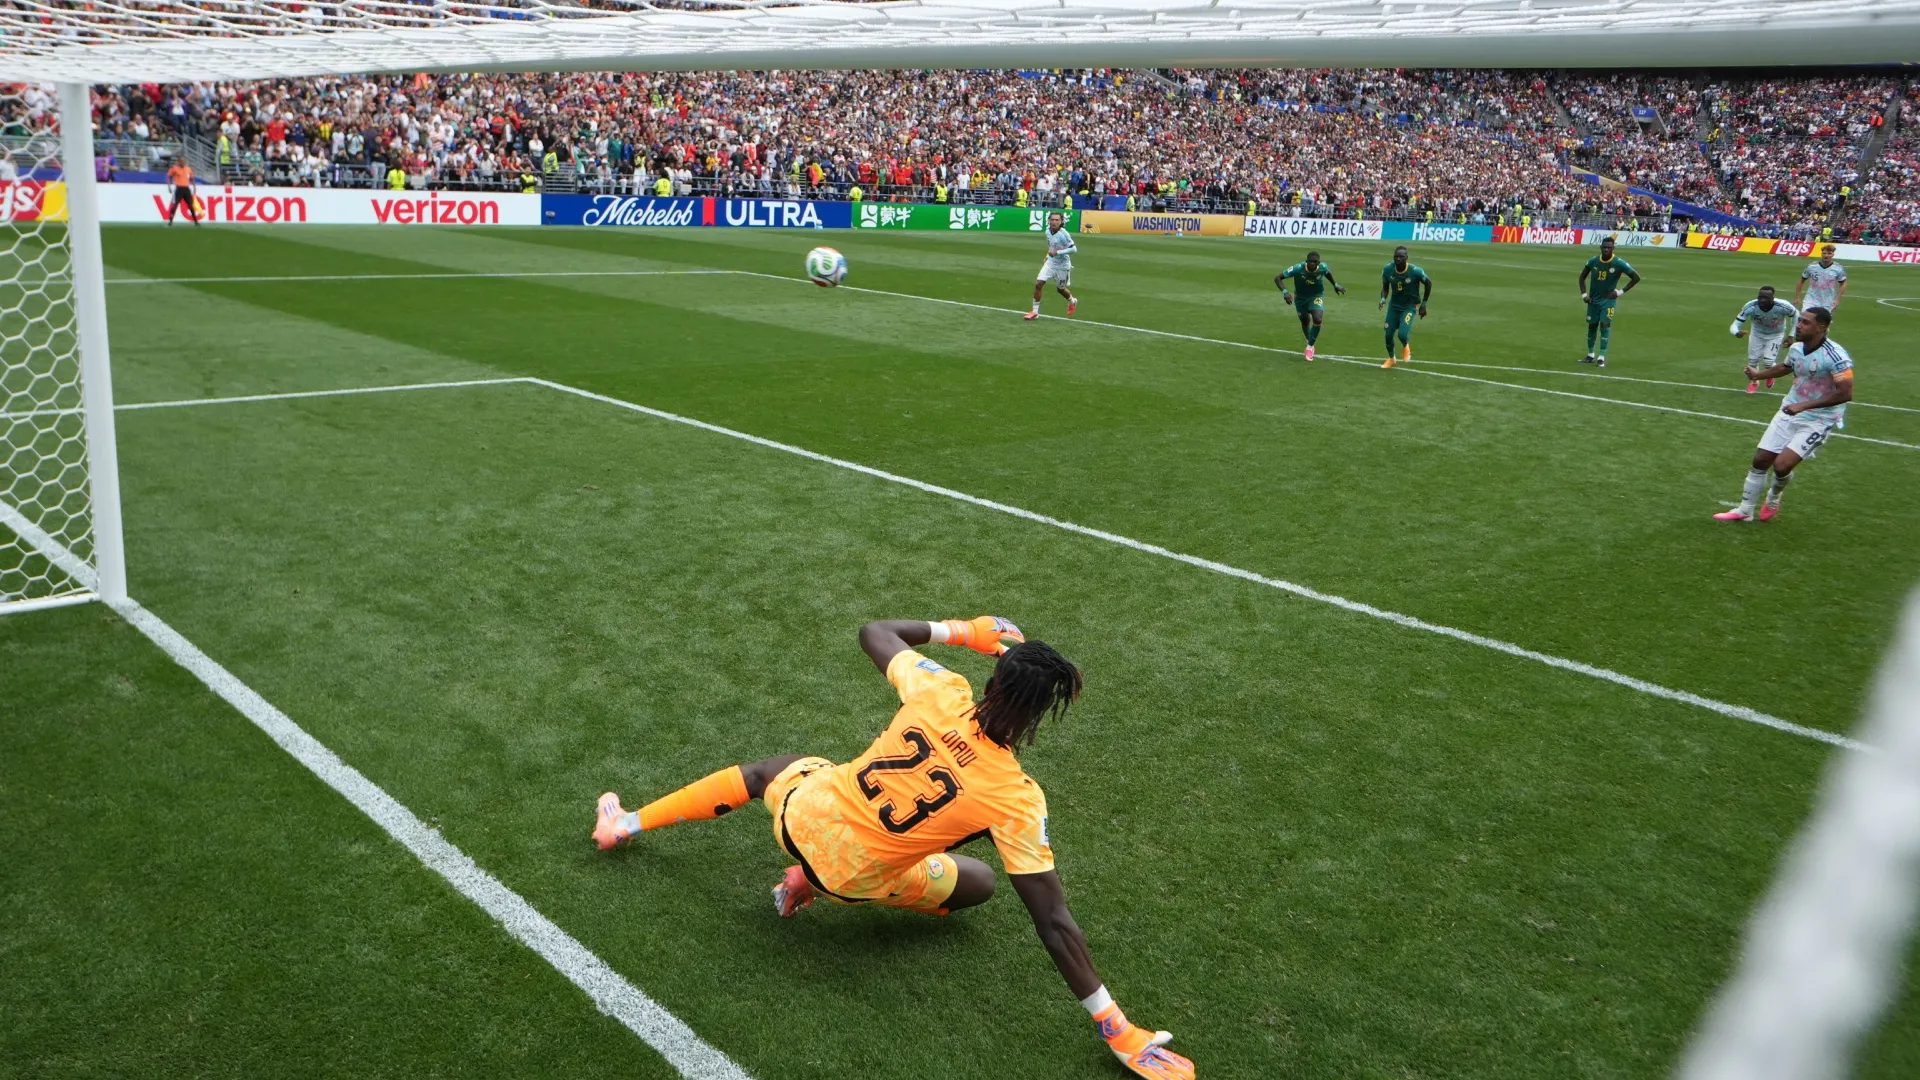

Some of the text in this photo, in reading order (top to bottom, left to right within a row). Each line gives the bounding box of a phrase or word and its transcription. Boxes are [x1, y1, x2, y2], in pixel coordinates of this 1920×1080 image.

[371, 192, 498, 224] verizon
[583, 195, 818, 226] Michelob ULTRA
[1133, 216, 1200, 231] WASHINGTON
[1251, 219, 1365, 236] BANK OF AMERICA
[1412, 223, 1465, 241] Hisense
[1520, 227, 1575, 244] McDonald's
[1626, 231, 1648, 246] Dove
[1707, 235, 1740, 251] Lay's
[1775, 239, 1810, 256] Lay's
[1597, 271, 1606, 280] 19
[1397, 282, 1402, 291] 6
[1607, 307, 1615, 317] 19
[1806, 432, 1819, 445] 8
[941, 730, 978, 768] DIAW
[856, 726, 964, 834] 23
